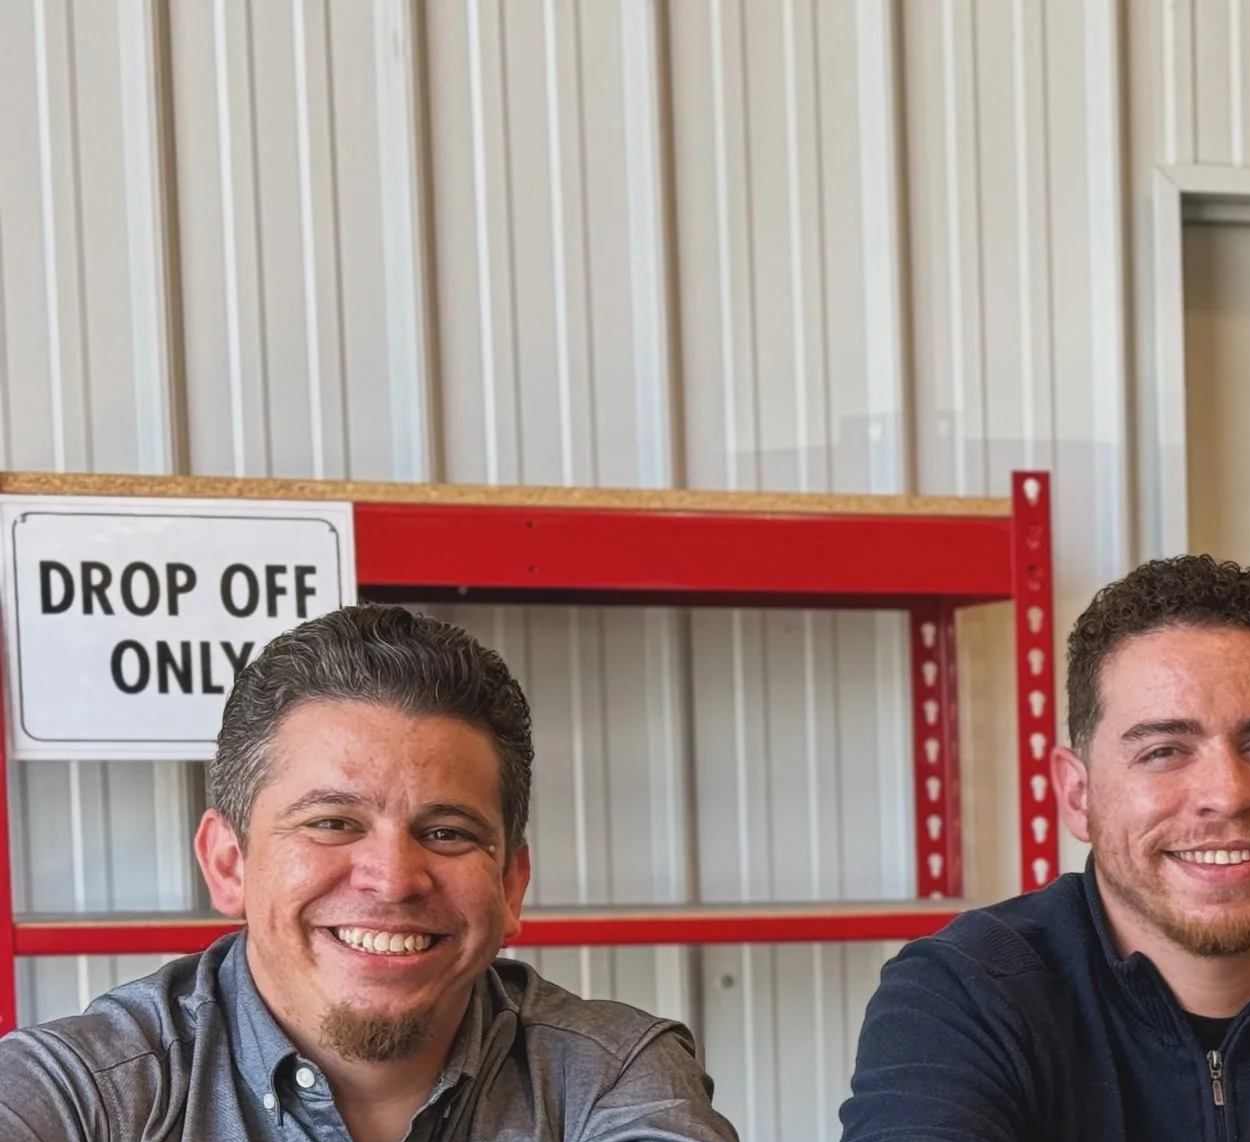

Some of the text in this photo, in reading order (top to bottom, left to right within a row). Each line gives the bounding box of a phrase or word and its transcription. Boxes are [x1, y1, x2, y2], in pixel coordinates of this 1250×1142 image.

[39, 560, 317, 619] DROP OFF
[110, 639, 255, 694] ONLY
